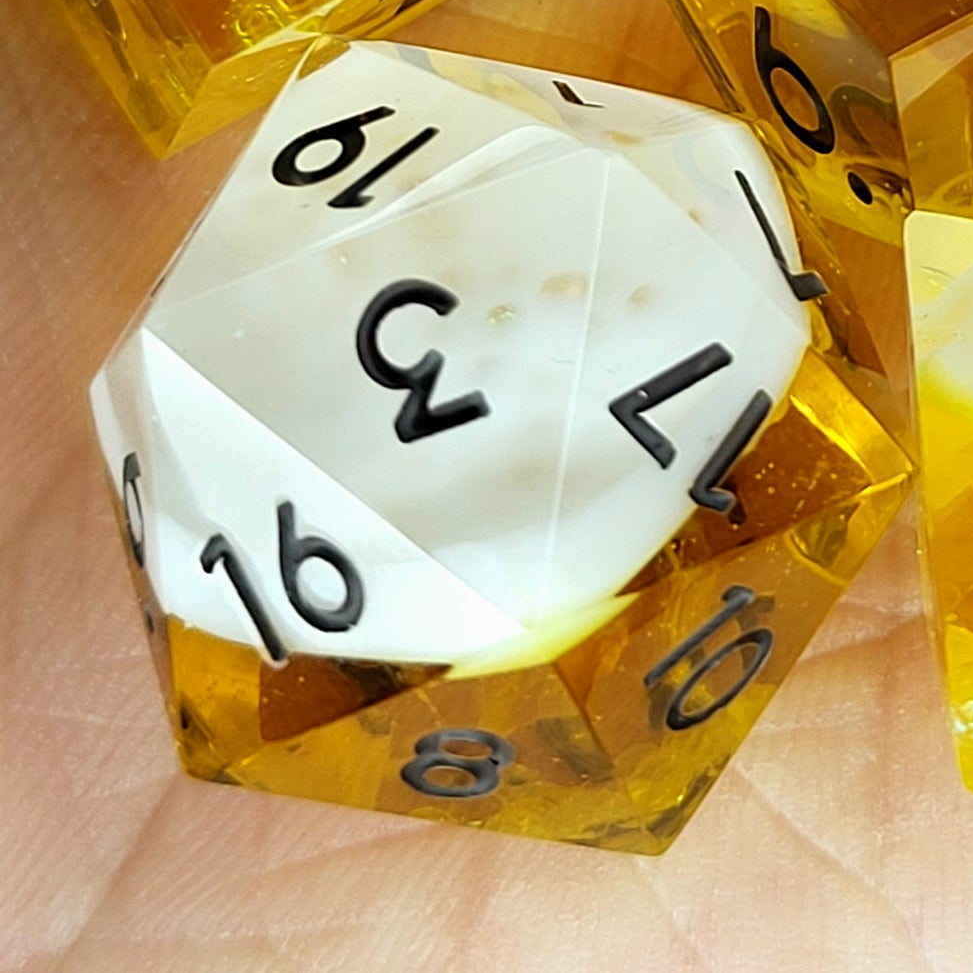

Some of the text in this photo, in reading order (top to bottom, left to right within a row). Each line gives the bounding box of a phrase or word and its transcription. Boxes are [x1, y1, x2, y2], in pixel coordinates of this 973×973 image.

[355, 278, 491, 444] 3
[200, 499, 365, 671] 16
[400, 727, 514, 798] 8
